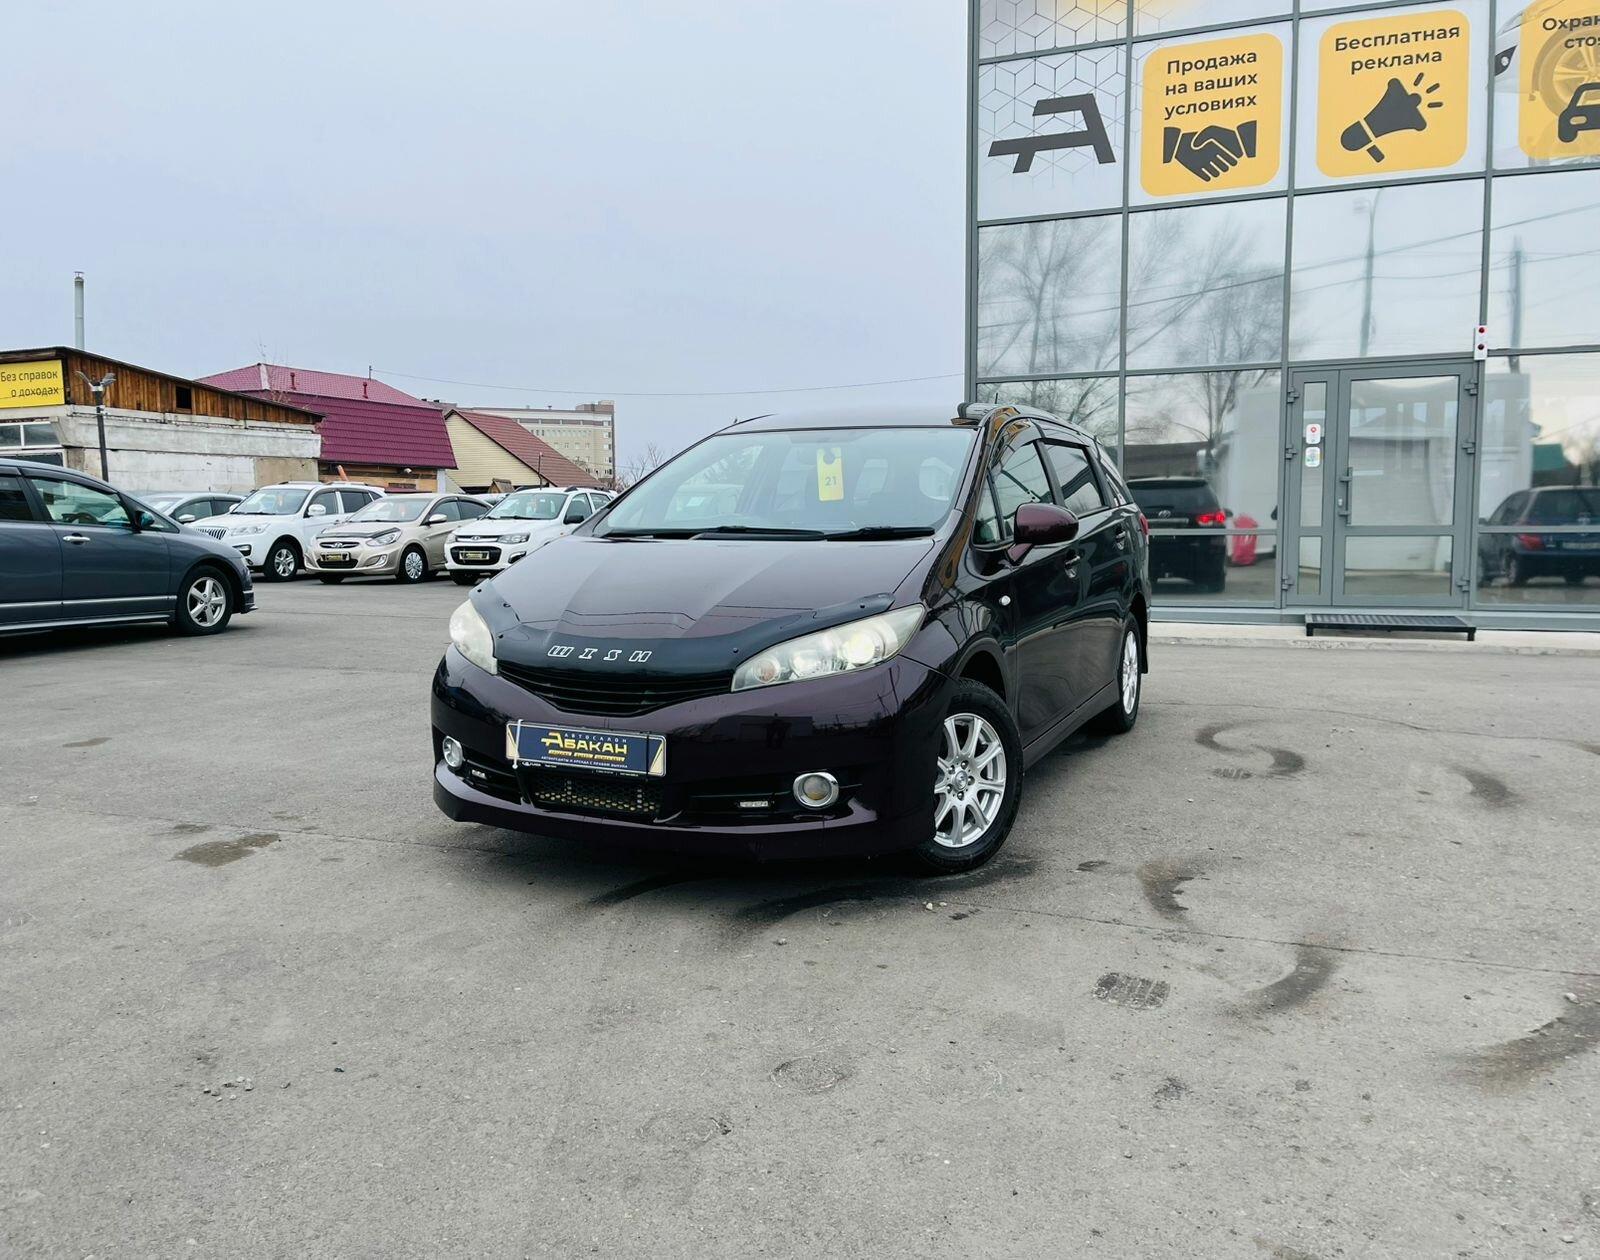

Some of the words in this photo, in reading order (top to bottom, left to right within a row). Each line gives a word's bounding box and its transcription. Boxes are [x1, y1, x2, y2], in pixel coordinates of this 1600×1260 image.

[1335, 26, 1460, 52] Бесплатная
[1564, 36, 1600, 49] сто
[1167, 52, 1257, 76] Продажа
[1351, 51, 1442, 75] реклама
[1165, 82, 1188, 96] на
[1194, 73, 1258, 92] ваших
[1164, 95, 1257, 120] условиях
[0, 371, 17, 382] Без
[18, 371, 58, 383] справок
[11, 389, 17, 398] о
[18, 387, 59, 398] доходах
[824, 476, 837, 486] 21
[547, 645, 653, 663] WISH
[564, 733, 628, 743] АВТОСАЛОН
